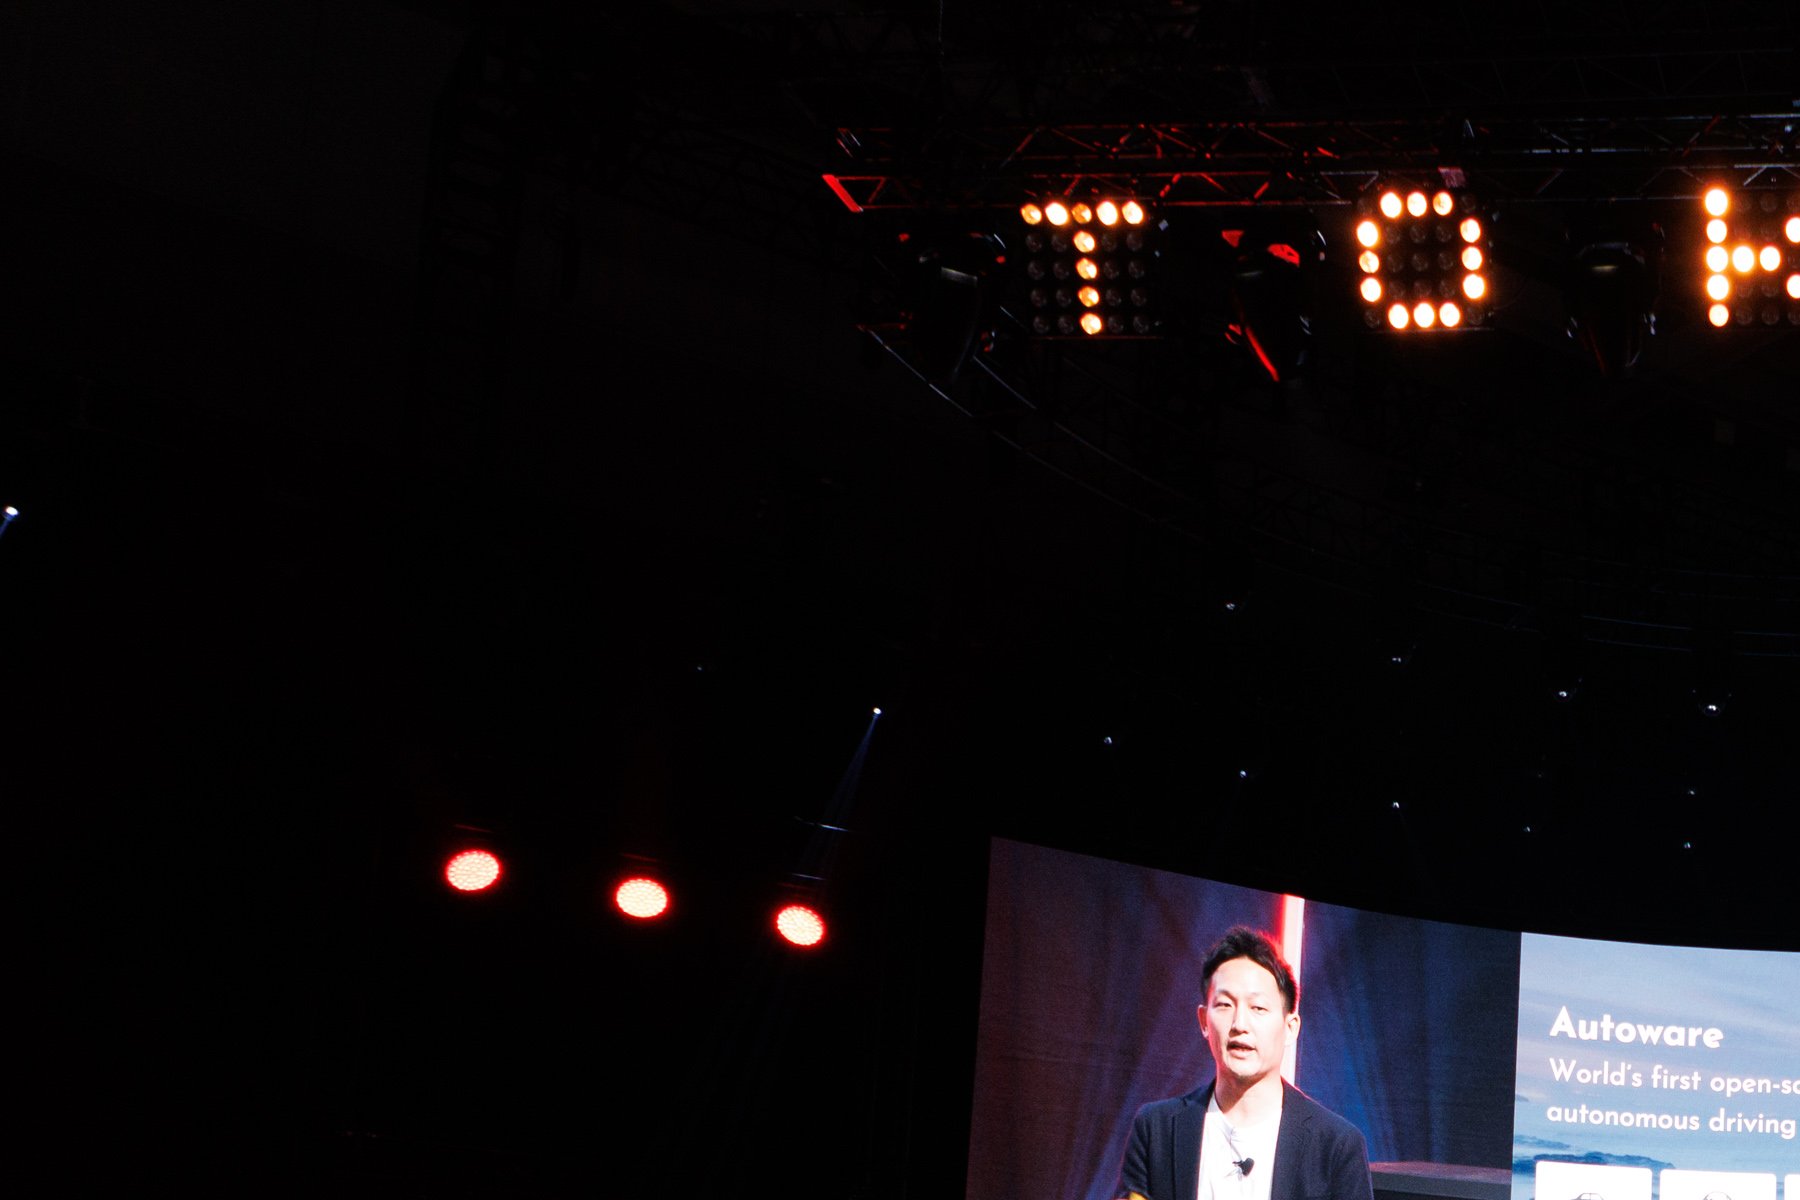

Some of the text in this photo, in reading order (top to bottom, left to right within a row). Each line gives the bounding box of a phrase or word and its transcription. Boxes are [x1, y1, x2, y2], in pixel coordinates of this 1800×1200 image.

[1549, 1005, 1724, 1049] Autoware
[1549, 1057, 1643, 1088] World's
[1651, 1064, 1702, 1091] first
[1546, 1104, 1700, 1131] autonomous
[1708, 1107, 1797, 1140] driving
